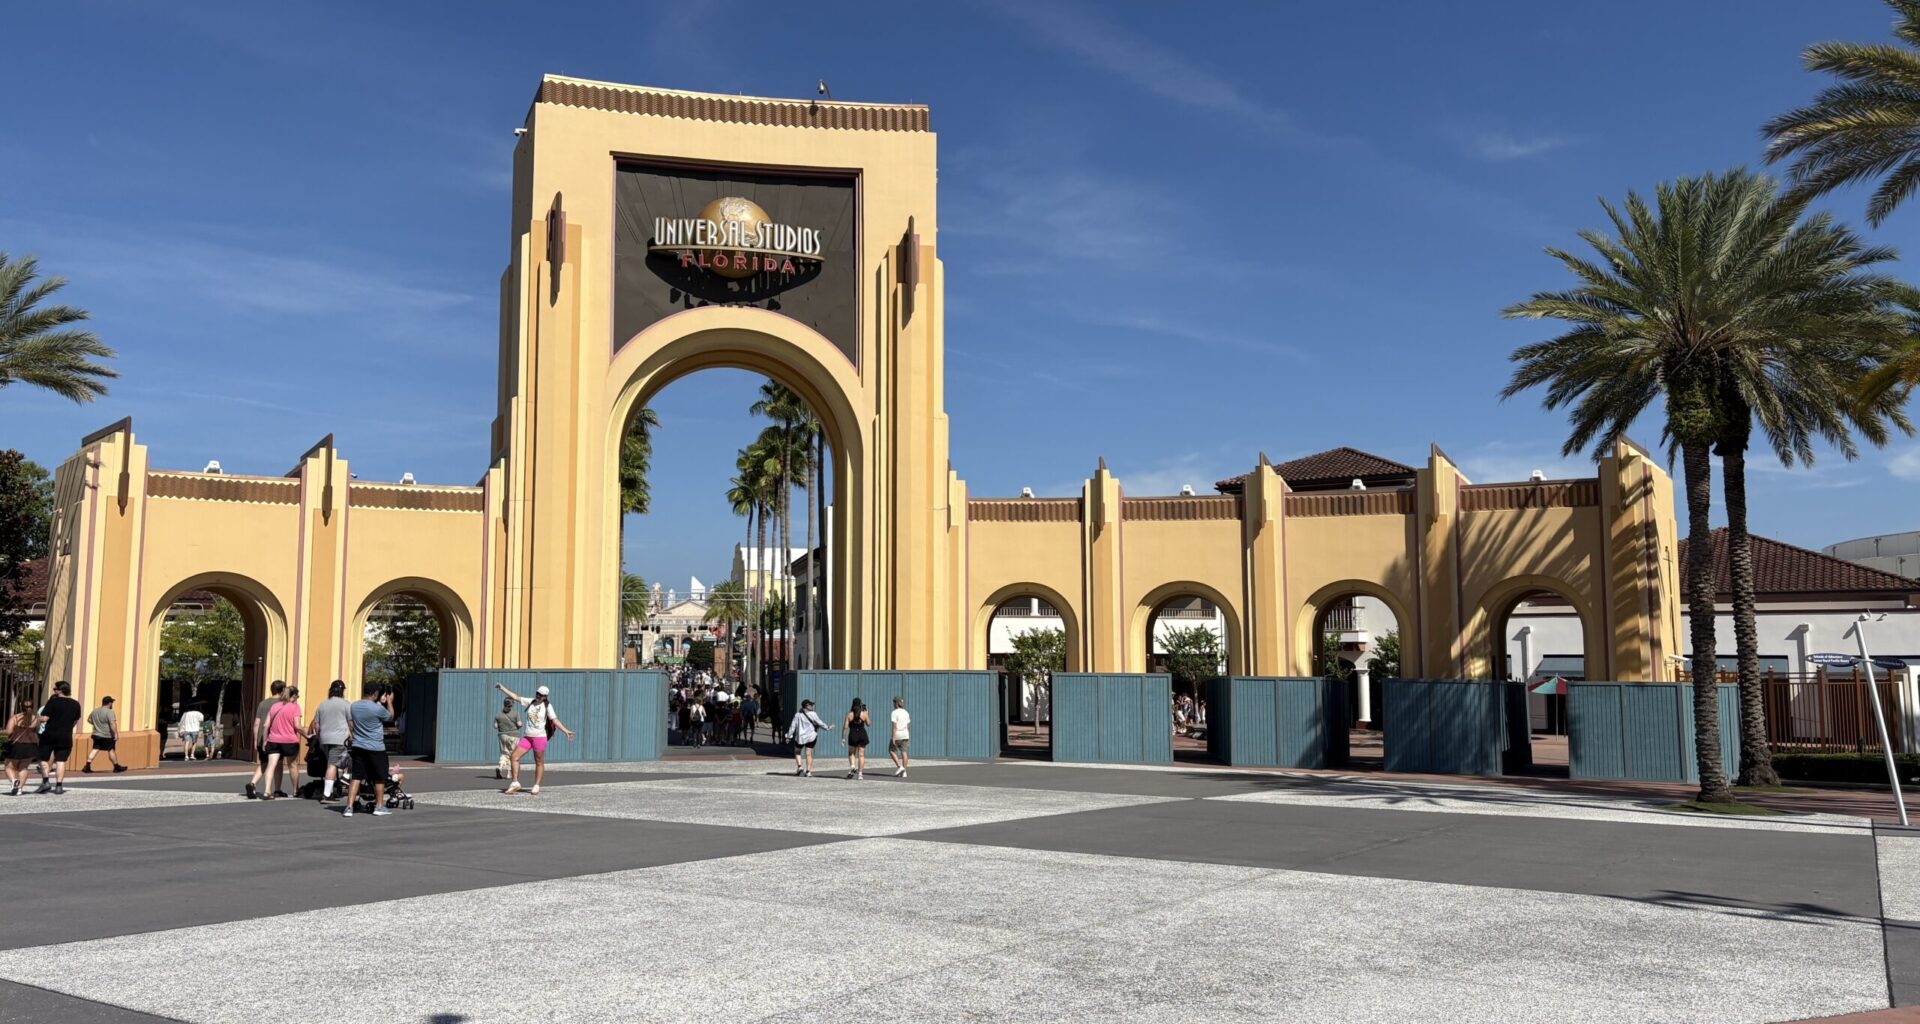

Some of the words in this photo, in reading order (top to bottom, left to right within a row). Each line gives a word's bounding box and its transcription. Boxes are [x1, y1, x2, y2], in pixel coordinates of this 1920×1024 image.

[654, 217, 751, 248] UNIVERSAL
[755, 220, 821, 256] STUDIOS
[681, 253, 796, 275] FLORIDA
